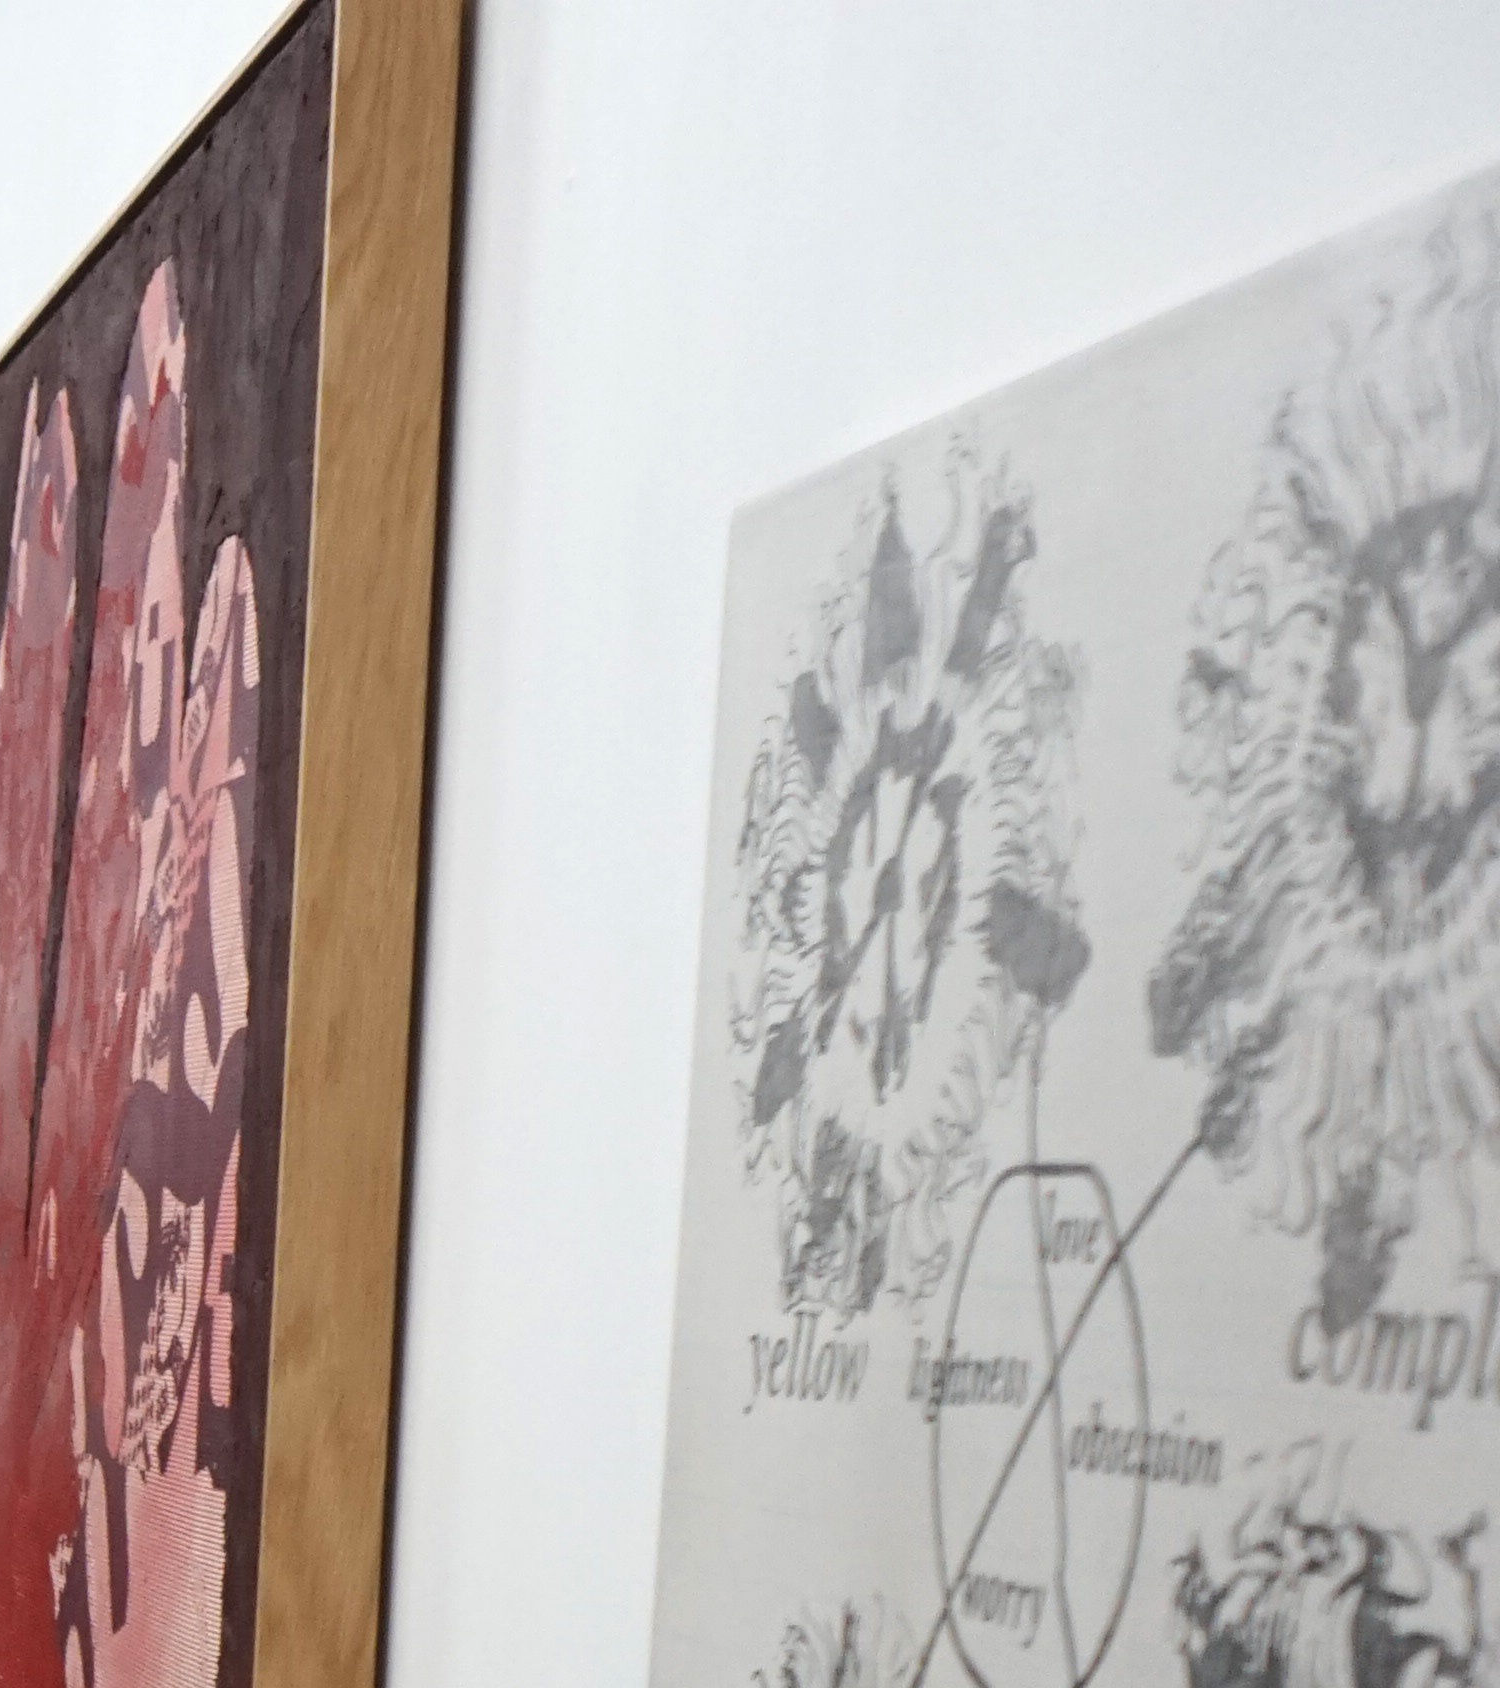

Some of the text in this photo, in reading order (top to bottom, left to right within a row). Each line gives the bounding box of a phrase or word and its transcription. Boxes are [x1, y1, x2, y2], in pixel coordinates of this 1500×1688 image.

[743, 1309, 870, 1415] yellow
[1287, 1272, 1500, 1432] compl
[961, 1572, 1047, 1649] worry
